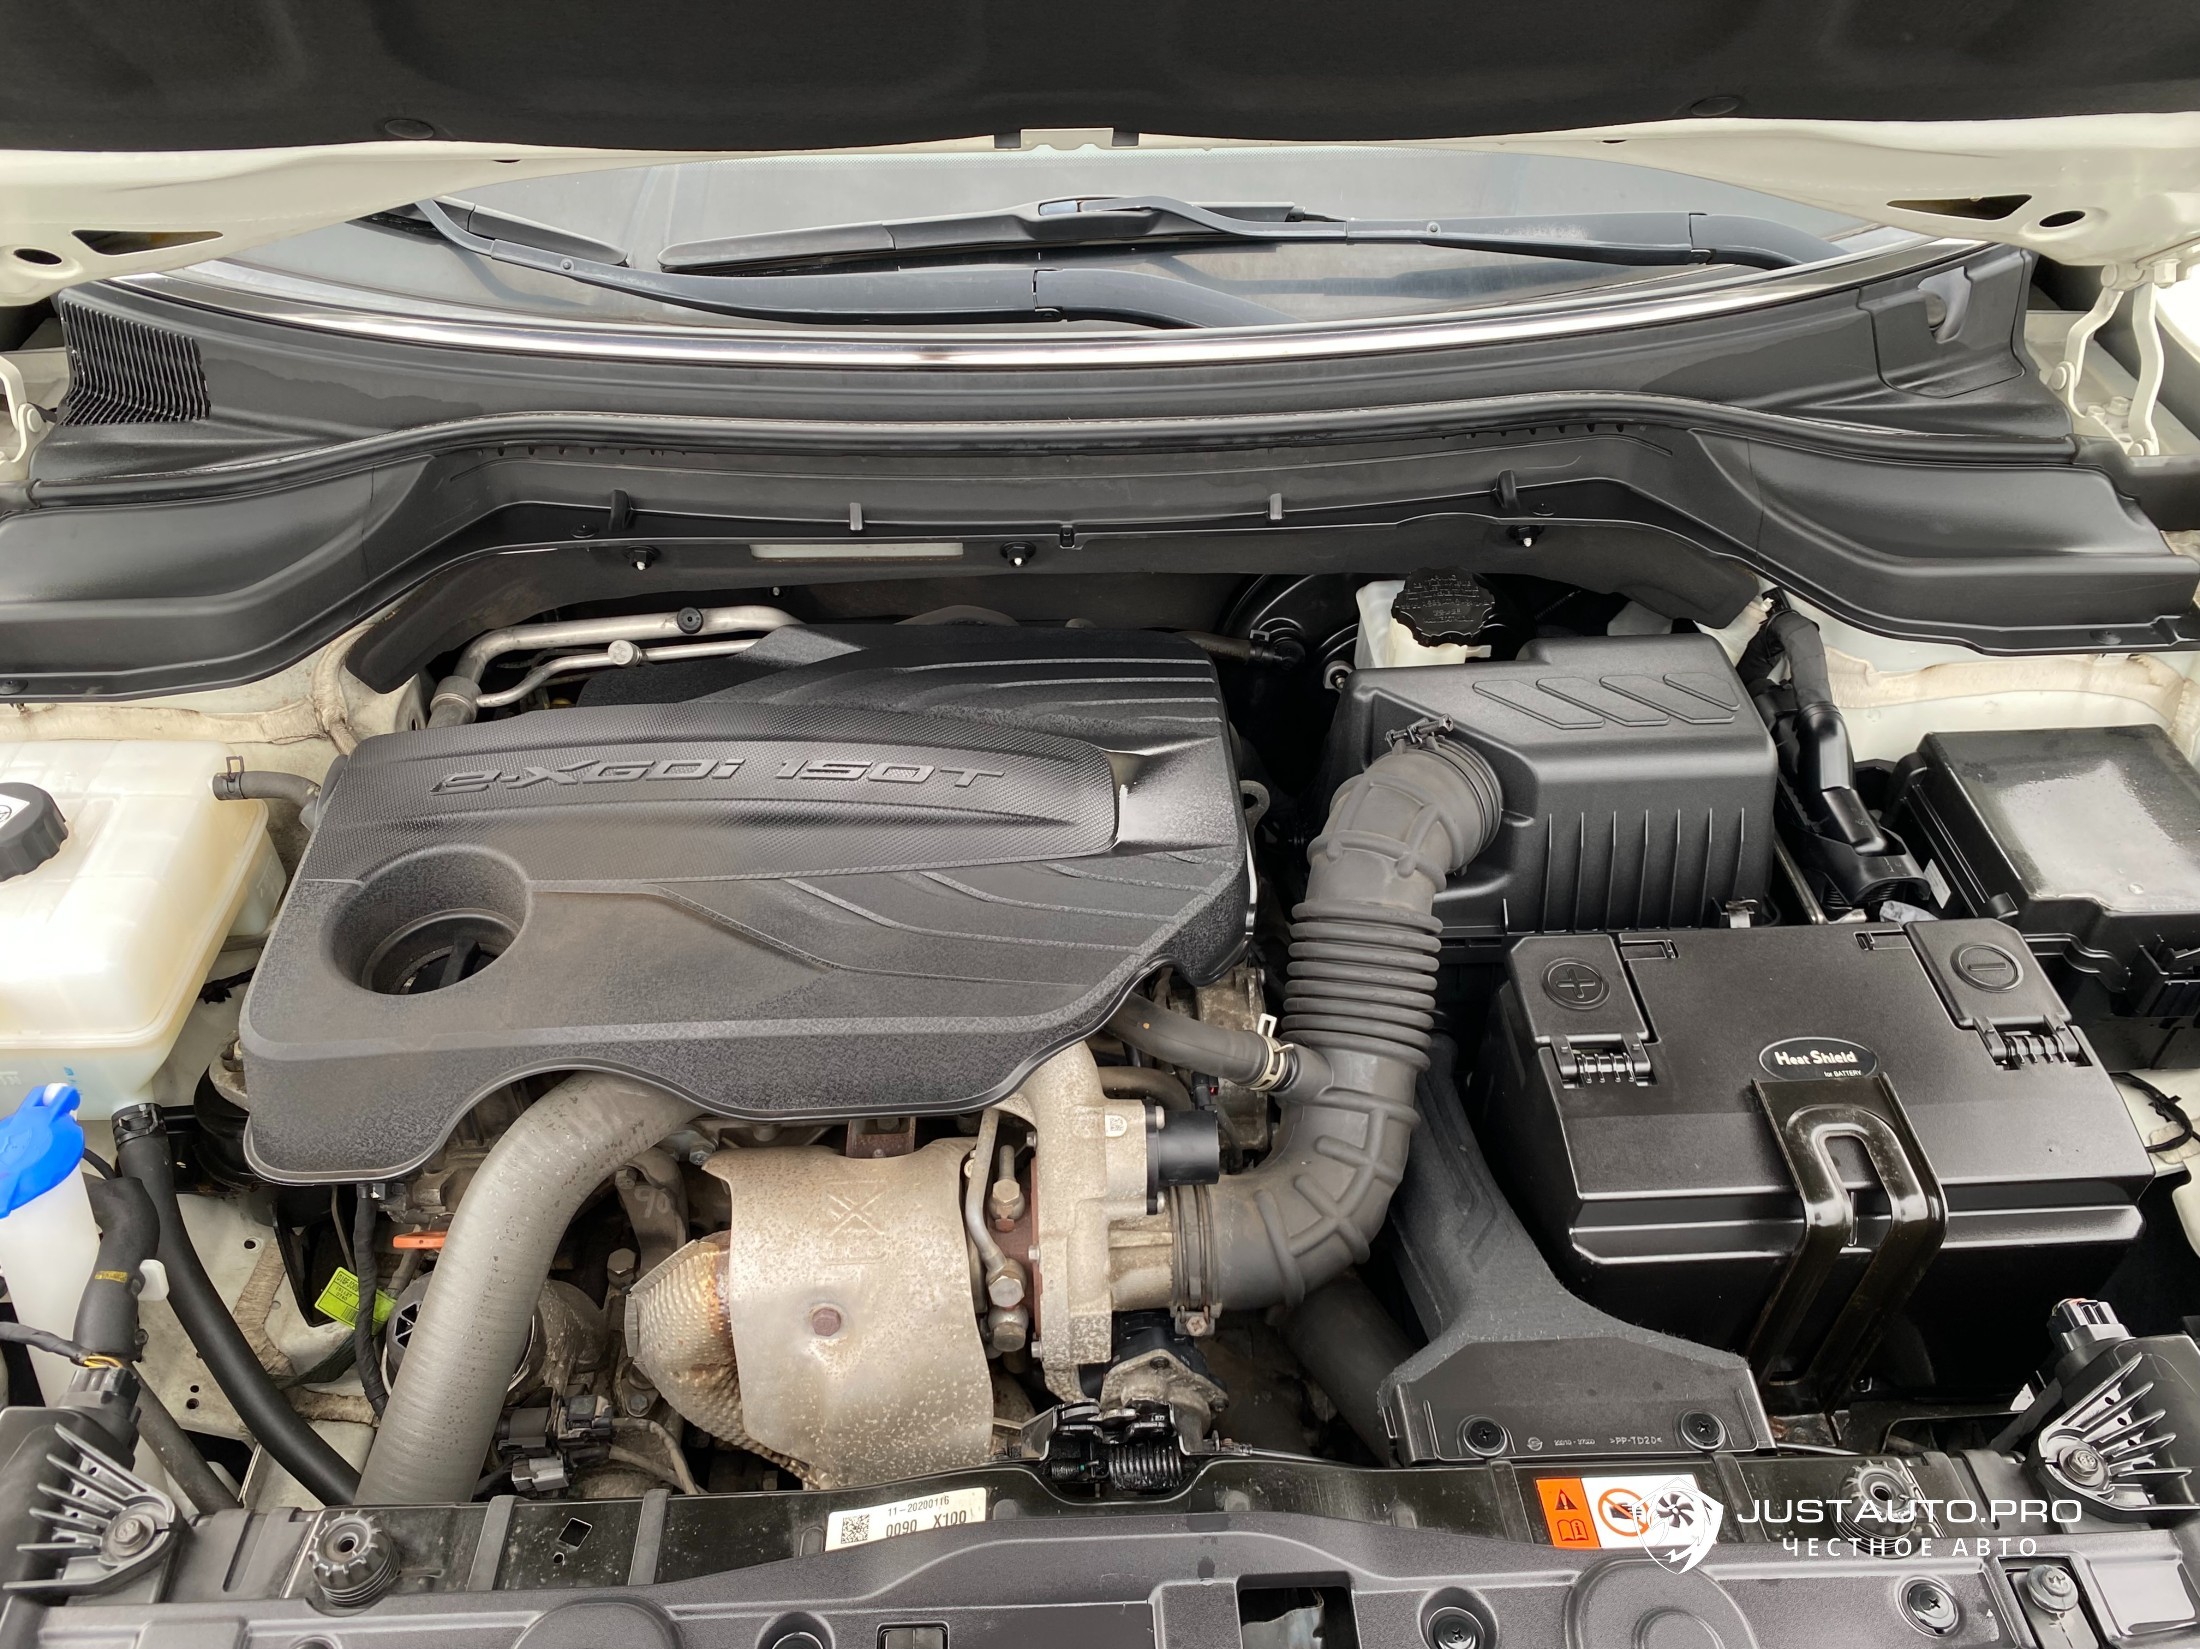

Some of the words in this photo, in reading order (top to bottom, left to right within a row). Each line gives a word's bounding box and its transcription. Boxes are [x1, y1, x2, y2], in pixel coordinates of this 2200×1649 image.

[775, 758, 1004, 788] 150T
[1774, 1050, 1811, 1066] Heat
[1810, 1049, 1858, 1065] Shield
[1823, 1070, 1833, 1078] for
[1833, 1069, 1862, 1077] BATTERY
[887, 1495, 950, 1517] 11-20200116
[885, 1519, 918, 1538] 0090
[933, 1510, 967, 1529] X100
